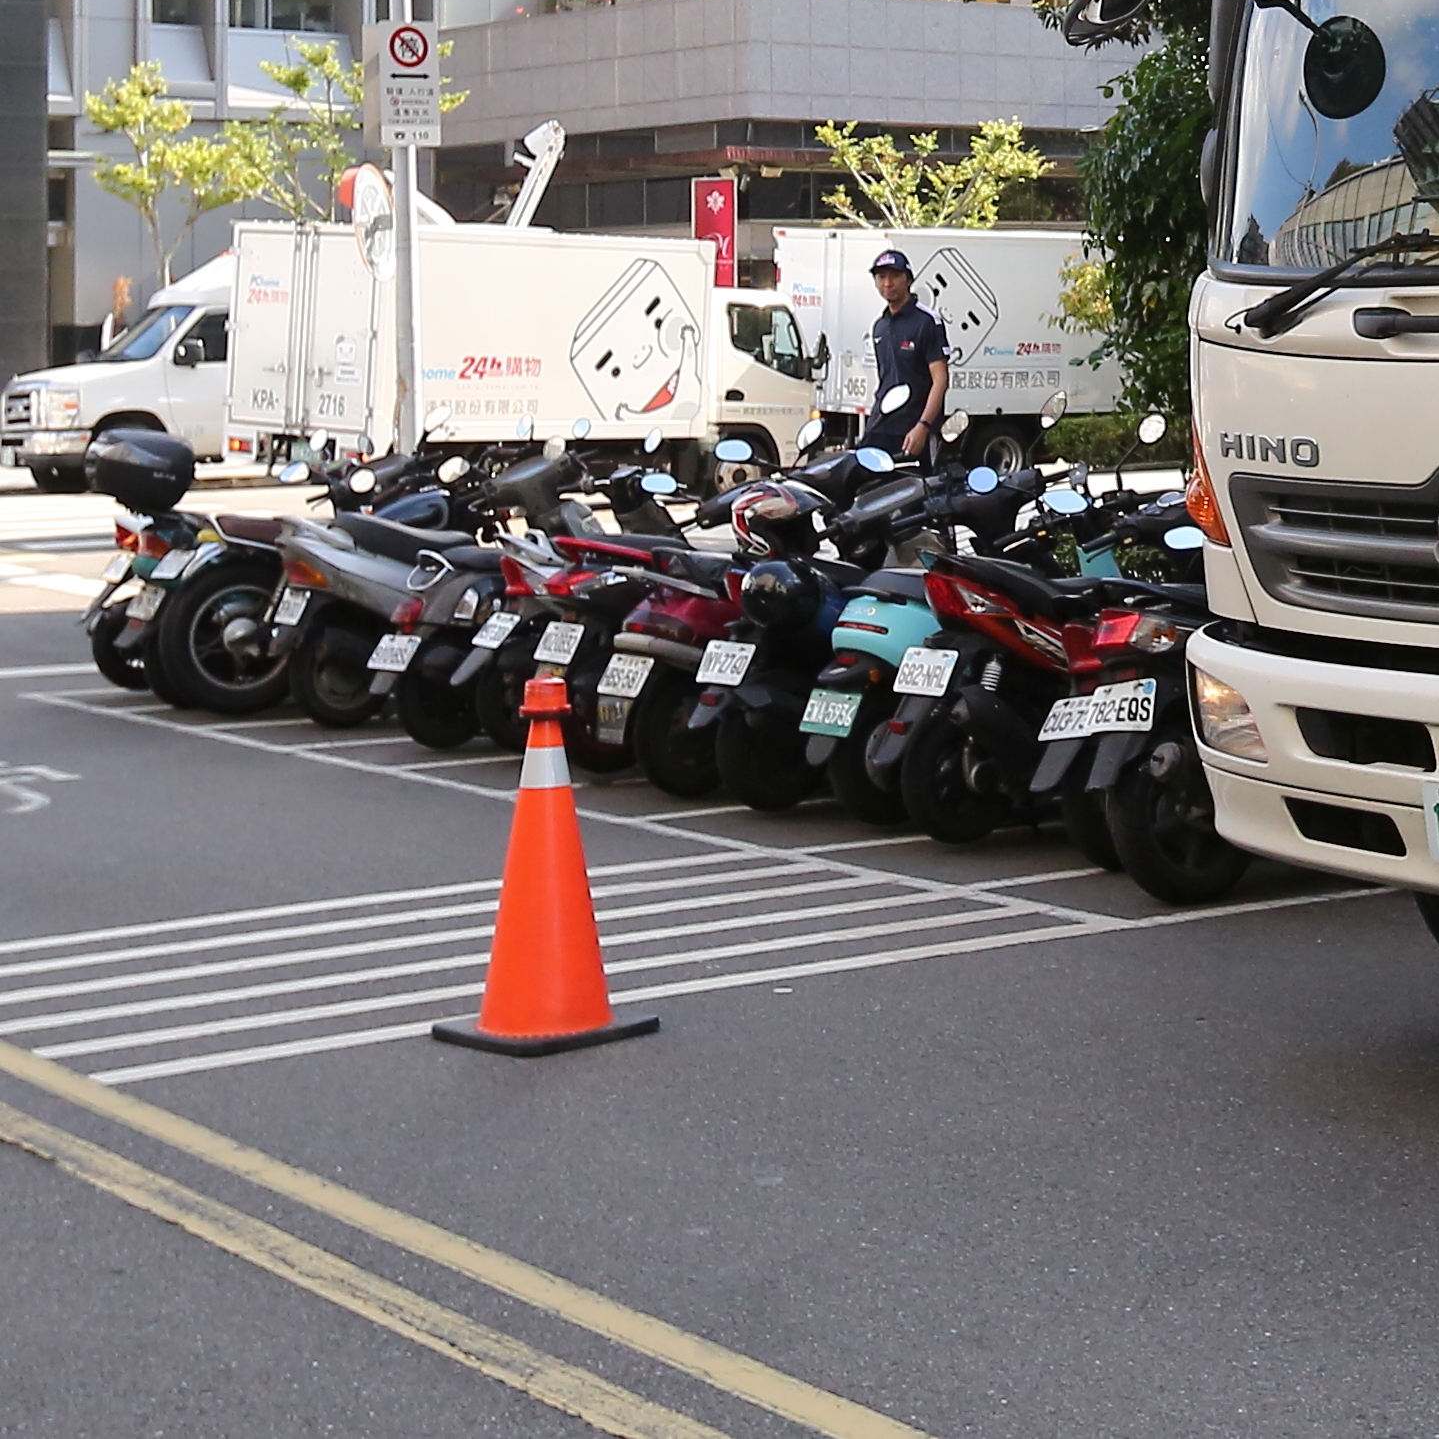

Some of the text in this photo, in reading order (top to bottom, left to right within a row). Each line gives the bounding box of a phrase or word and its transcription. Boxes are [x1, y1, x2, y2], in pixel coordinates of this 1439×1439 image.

[317, 394, 345, 416] 2716
[1218, 431, 1320, 467] HINO
[1088, 697, 1151, 726] 782-EQS
